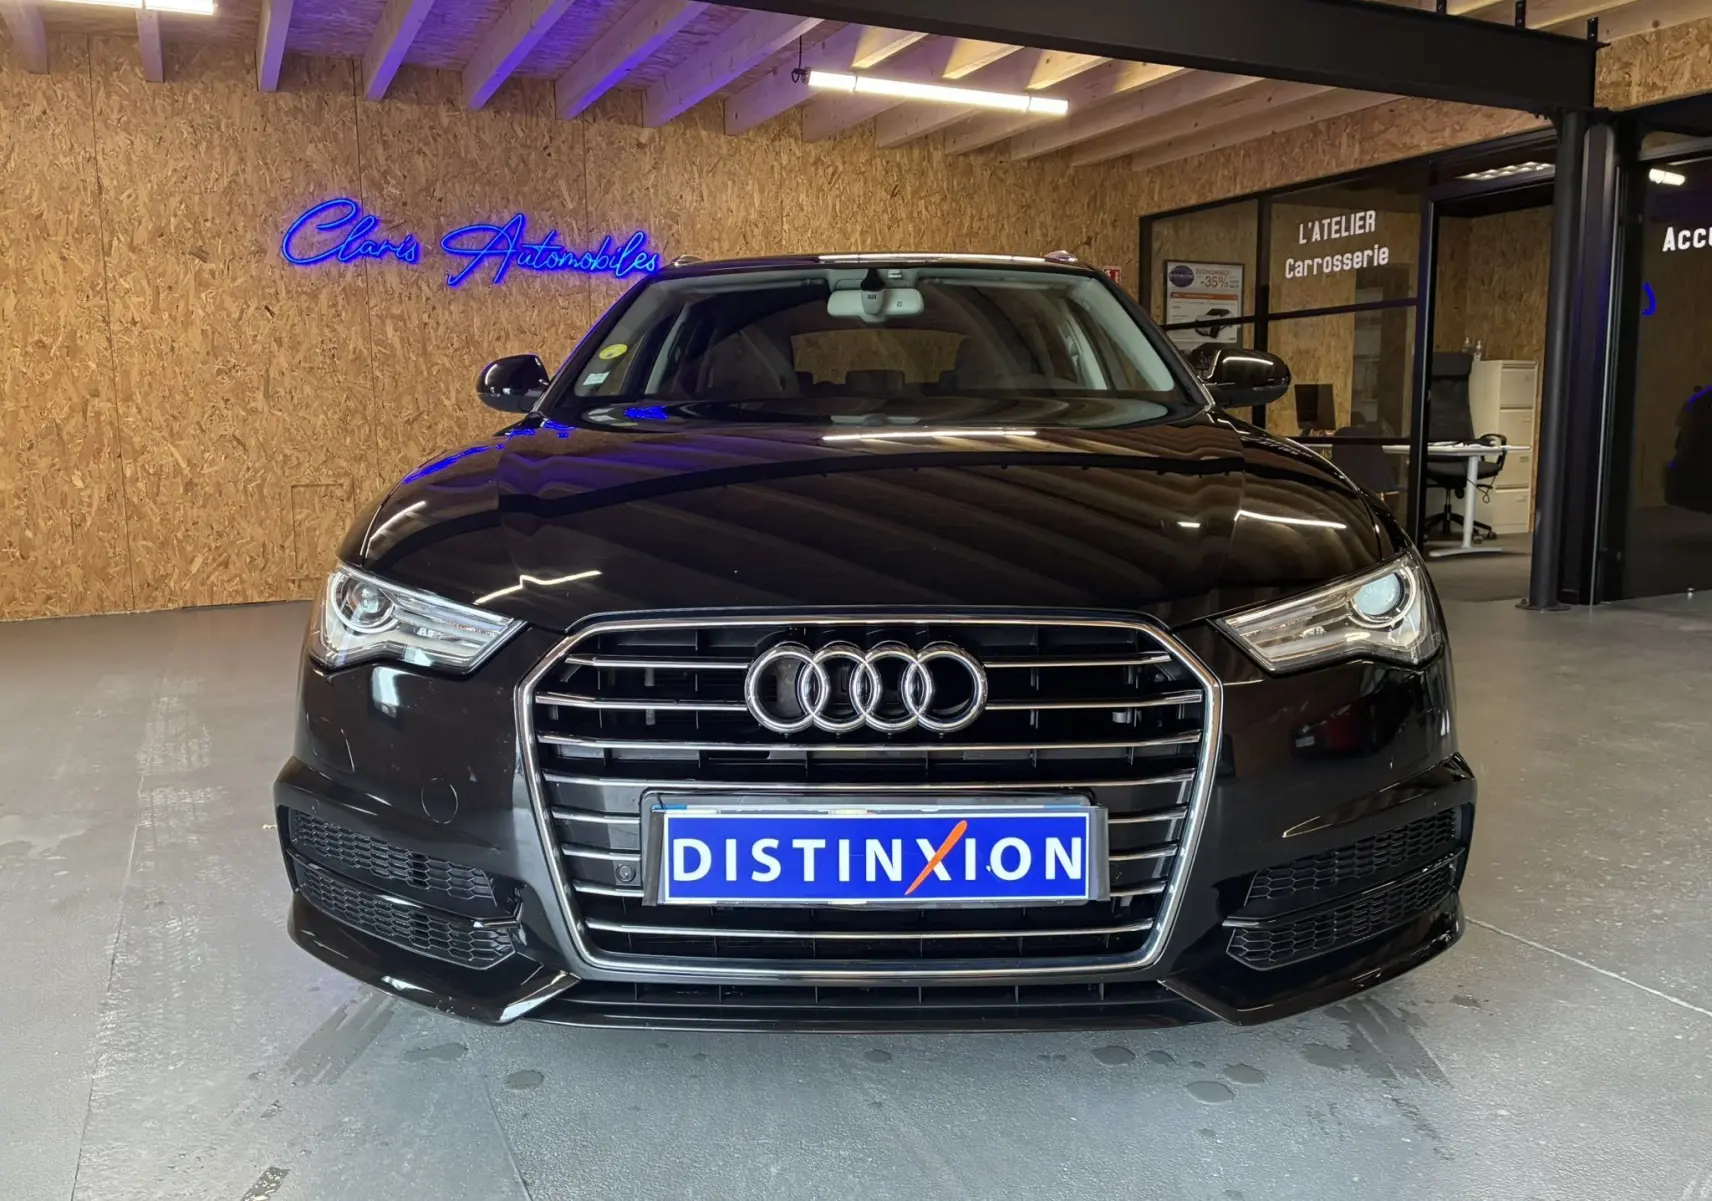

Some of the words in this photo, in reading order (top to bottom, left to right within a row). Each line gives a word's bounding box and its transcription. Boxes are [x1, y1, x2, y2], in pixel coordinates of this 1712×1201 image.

[281, 198, 418, 265] Claris
[440, 213, 660, 286] Automobiles
[1298, 210, 1376, 245] L'ATELIER
[1285, 244, 1390, 280] Carrosserie
[1200, 275, 1229, 288] -35%
[672, 820, 1083, 896] DISTINXION
